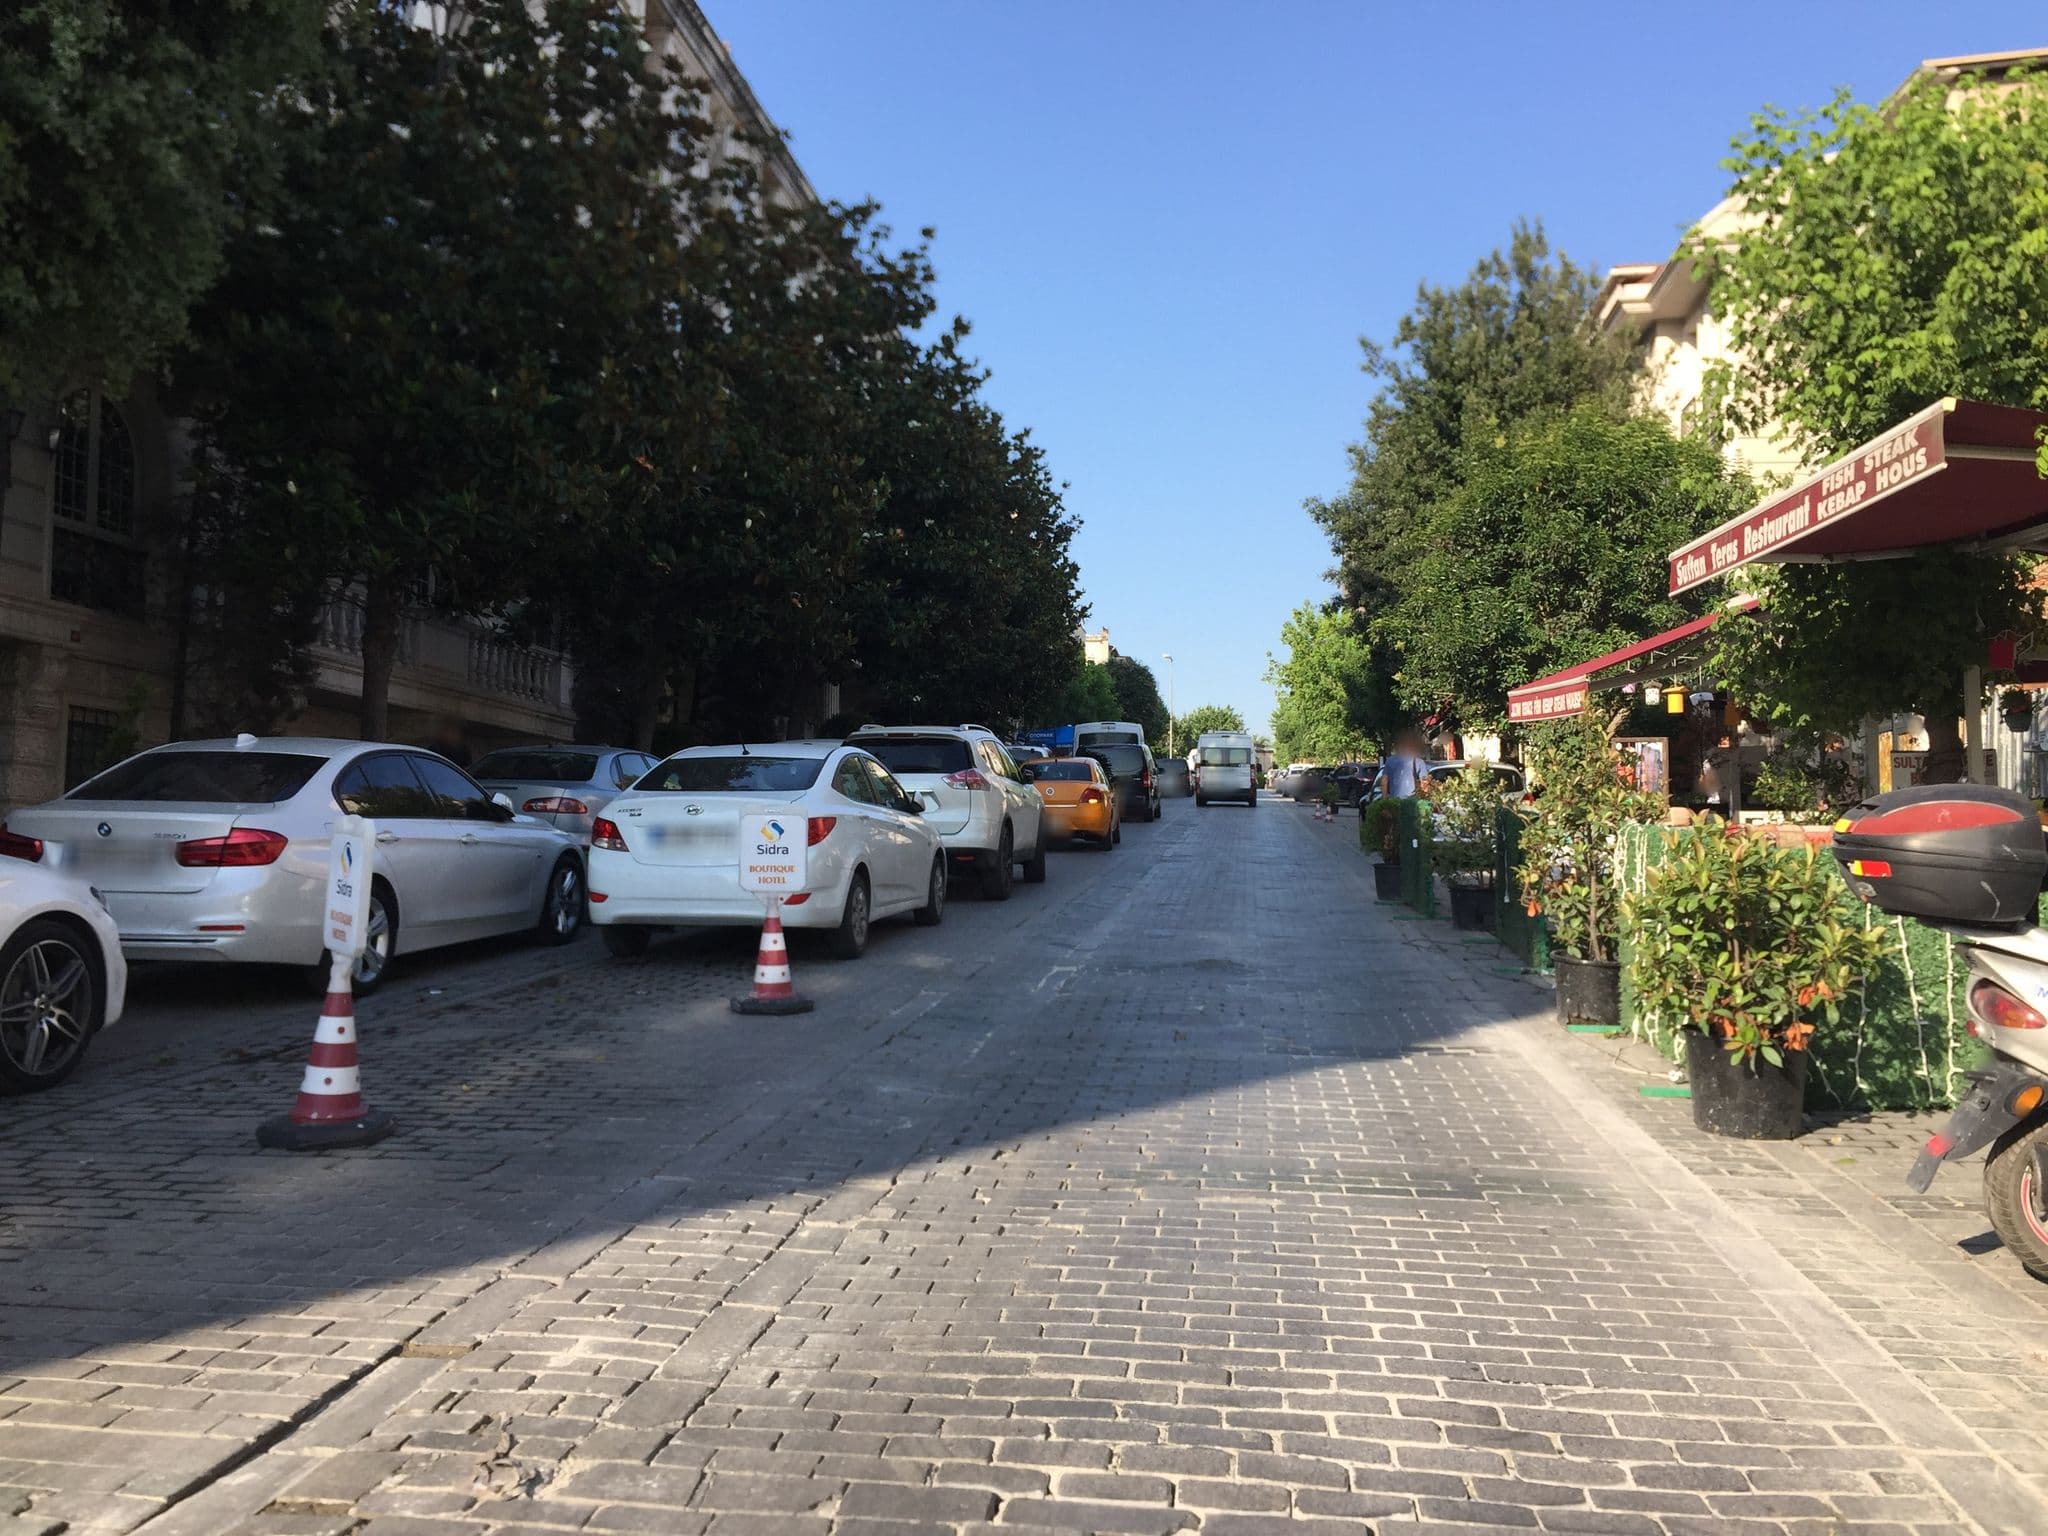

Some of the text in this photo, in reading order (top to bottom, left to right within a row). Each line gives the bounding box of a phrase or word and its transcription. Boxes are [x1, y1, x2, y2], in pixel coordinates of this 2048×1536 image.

[1822, 427, 1919, 496] FISH STEAK
[1817, 447, 1928, 520] KEBAP HOUS
[1676, 554, 1706, 586] Sultan
[1743, 495, 1810, 555] Restaurant
[749, 865, 795, 873] BOUTIQUE
[756, 844, 789, 855] Sidra
[758, 876, 785, 884] HOTEL
